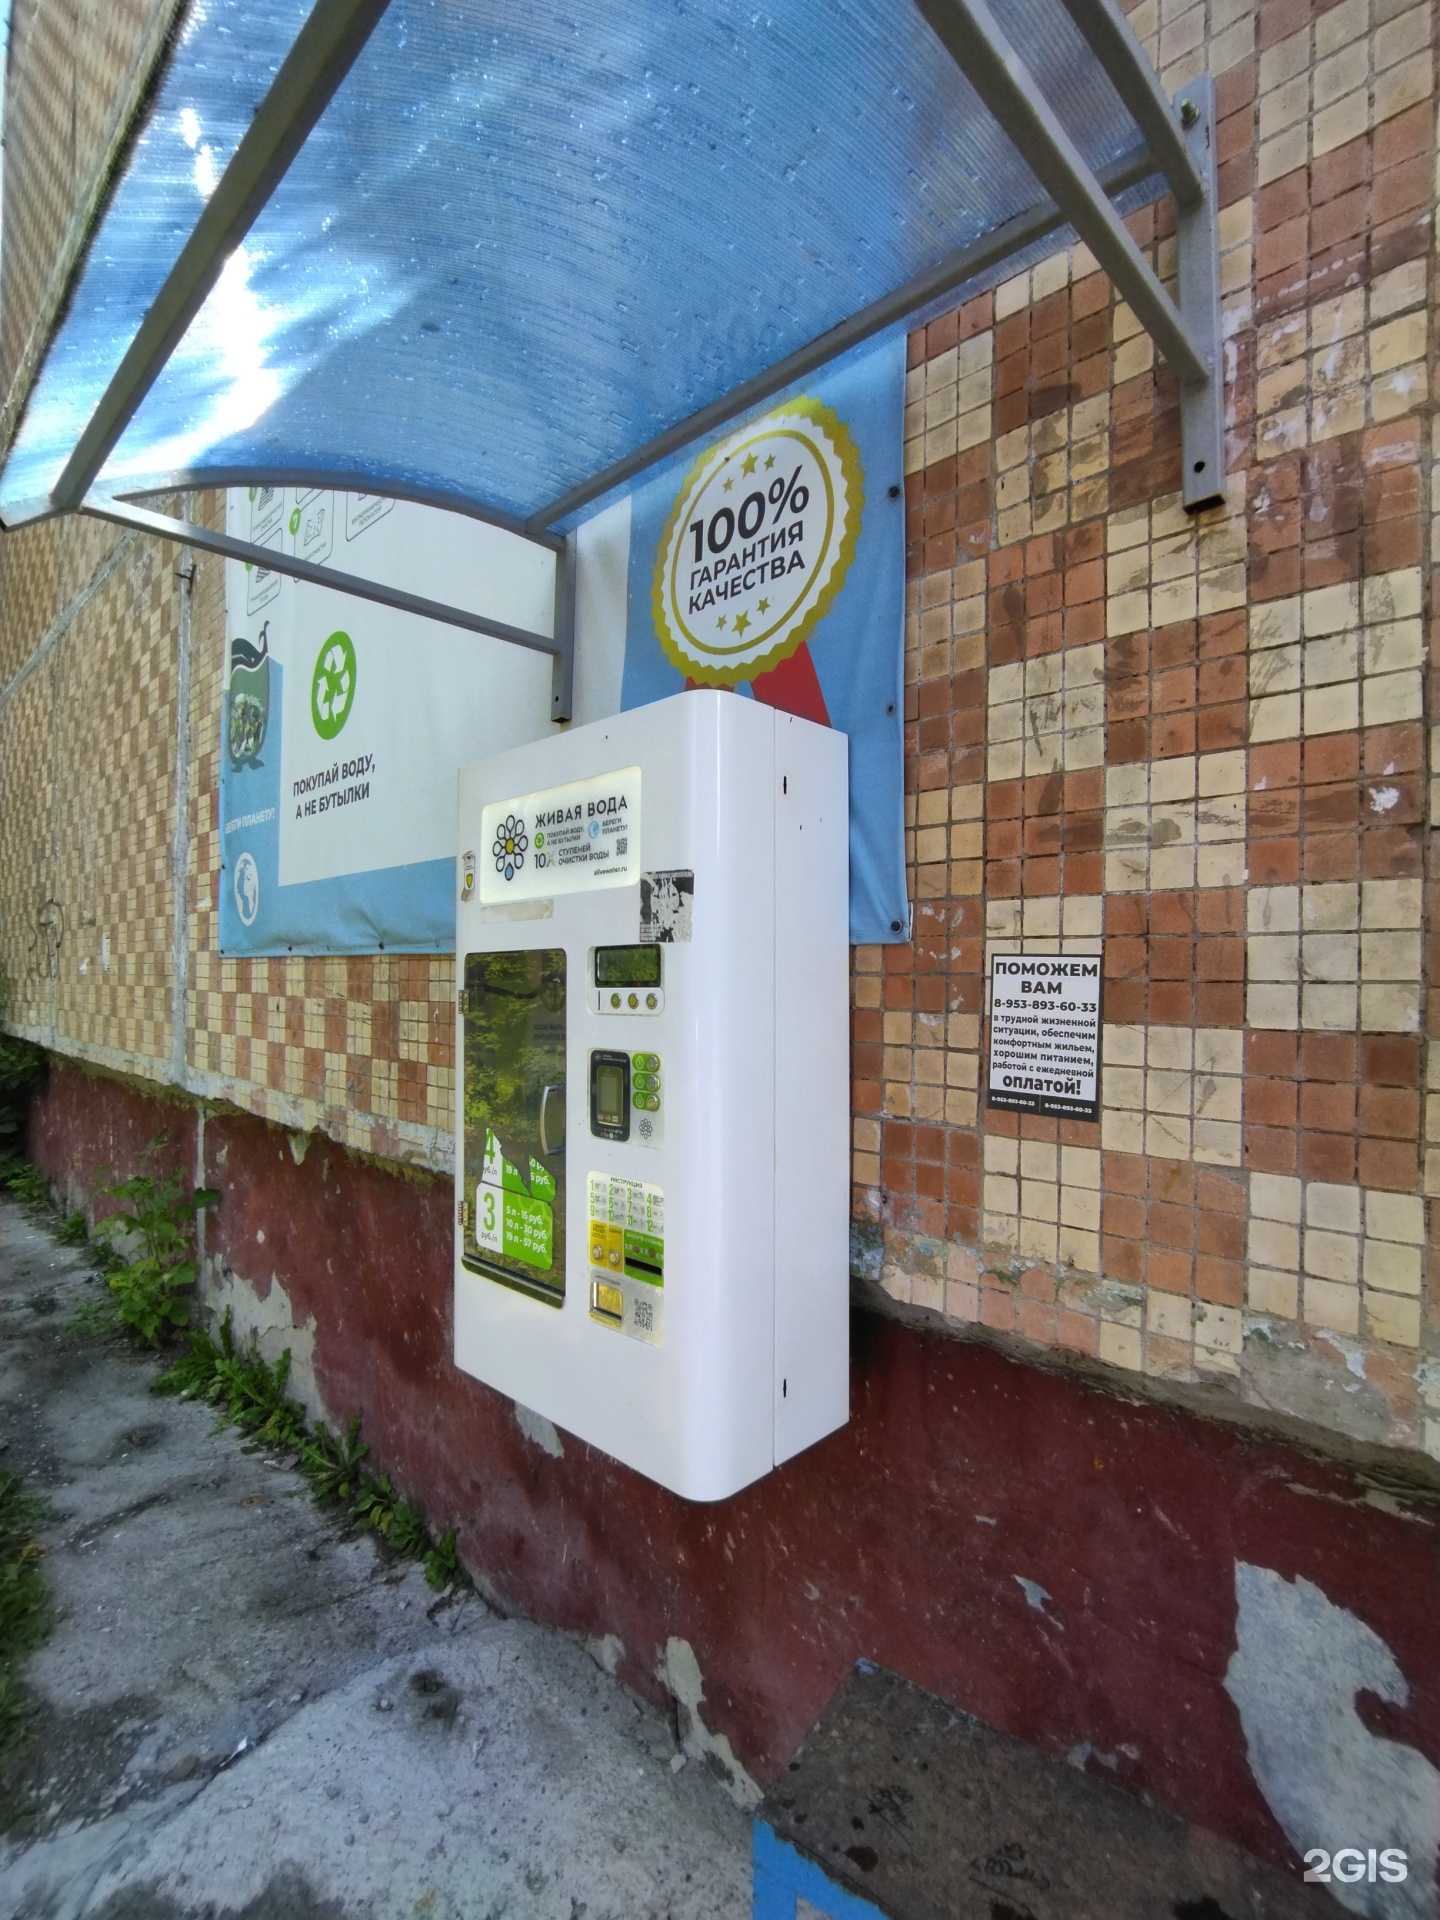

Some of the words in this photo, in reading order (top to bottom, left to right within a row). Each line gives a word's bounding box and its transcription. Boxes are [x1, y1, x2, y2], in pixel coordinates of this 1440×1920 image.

[689, 464, 810, 564] 100%
[690, 520, 804, 590] ГАРАНТИЯ
[688, 550, 805, 615] КАЧЕСТВА
[293, 763, 339, 797] ПОКУПАЙ
[342, 753, 376, 780] ВОДУ,
[296, 804, 303, 820] А
[305, 799, 317, 816] НЕ
[318, 781, 370, 812] БУТЫЛКИ
[535, 804, 582, 829] ЖИВАЯ
[588, 795, 628, 817] ВОДА
[558, 843, 591, 857] СТУПЕНЕЙ
[558, 854, 588, 866] ОЧИСТКИ
[589, 849, 609, 861] ВОДЫ
[534, 852, 547, 869] 10
[995, 962, 1098, 977] ПОМОЖЕМ
[1021, 981, 1062, 994] ВАМ
[994, 999, 1097, 1013] 8-953-893-60-33
[1001, 1014, 1039, 1024] трудной
[1041, 1017, 1096, 1028] жизненной
[993, 1026, 1040, 1037] ситуации,
[1041, 1028, 1096, 1040] обеспечим
[993, 1038, 1052, 1050] комфортным
[1054, 1043, 1095, 1053] жильем,
[993, 1049, 1037, 1060] хорошим
[1040, 1053, 1094, 1067] питанием,
[992, 1061, 1027, 1071] работой
[1036, 1066, 1094, 1078] ежедневной
[1003, 1075, 1081, 1096] оплатой!
[484, 1192, 495, 1231] 3
